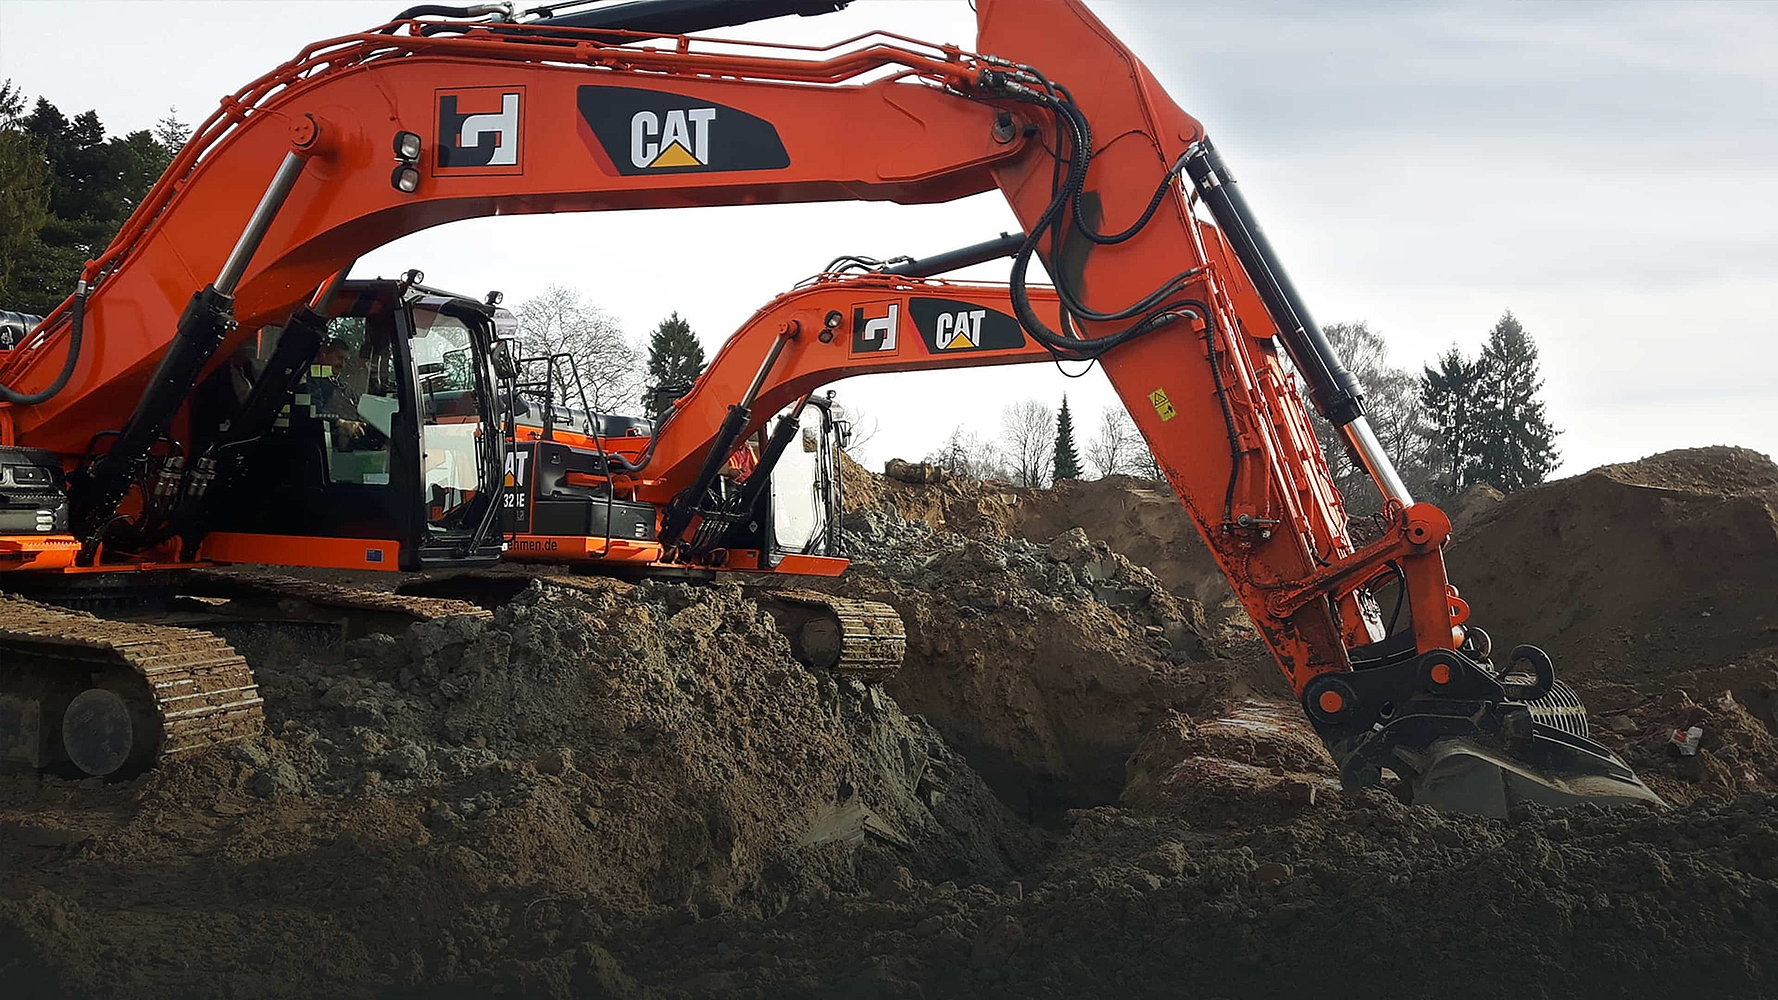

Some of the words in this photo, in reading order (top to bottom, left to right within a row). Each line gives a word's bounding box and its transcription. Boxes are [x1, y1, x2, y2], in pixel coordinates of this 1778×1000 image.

[630, 107, 717, 169] CAT
[935, 309, 986, 350] CAT
[504, 451, 528, 486] AT
[507, 538, 557, 551] ehmen.de
